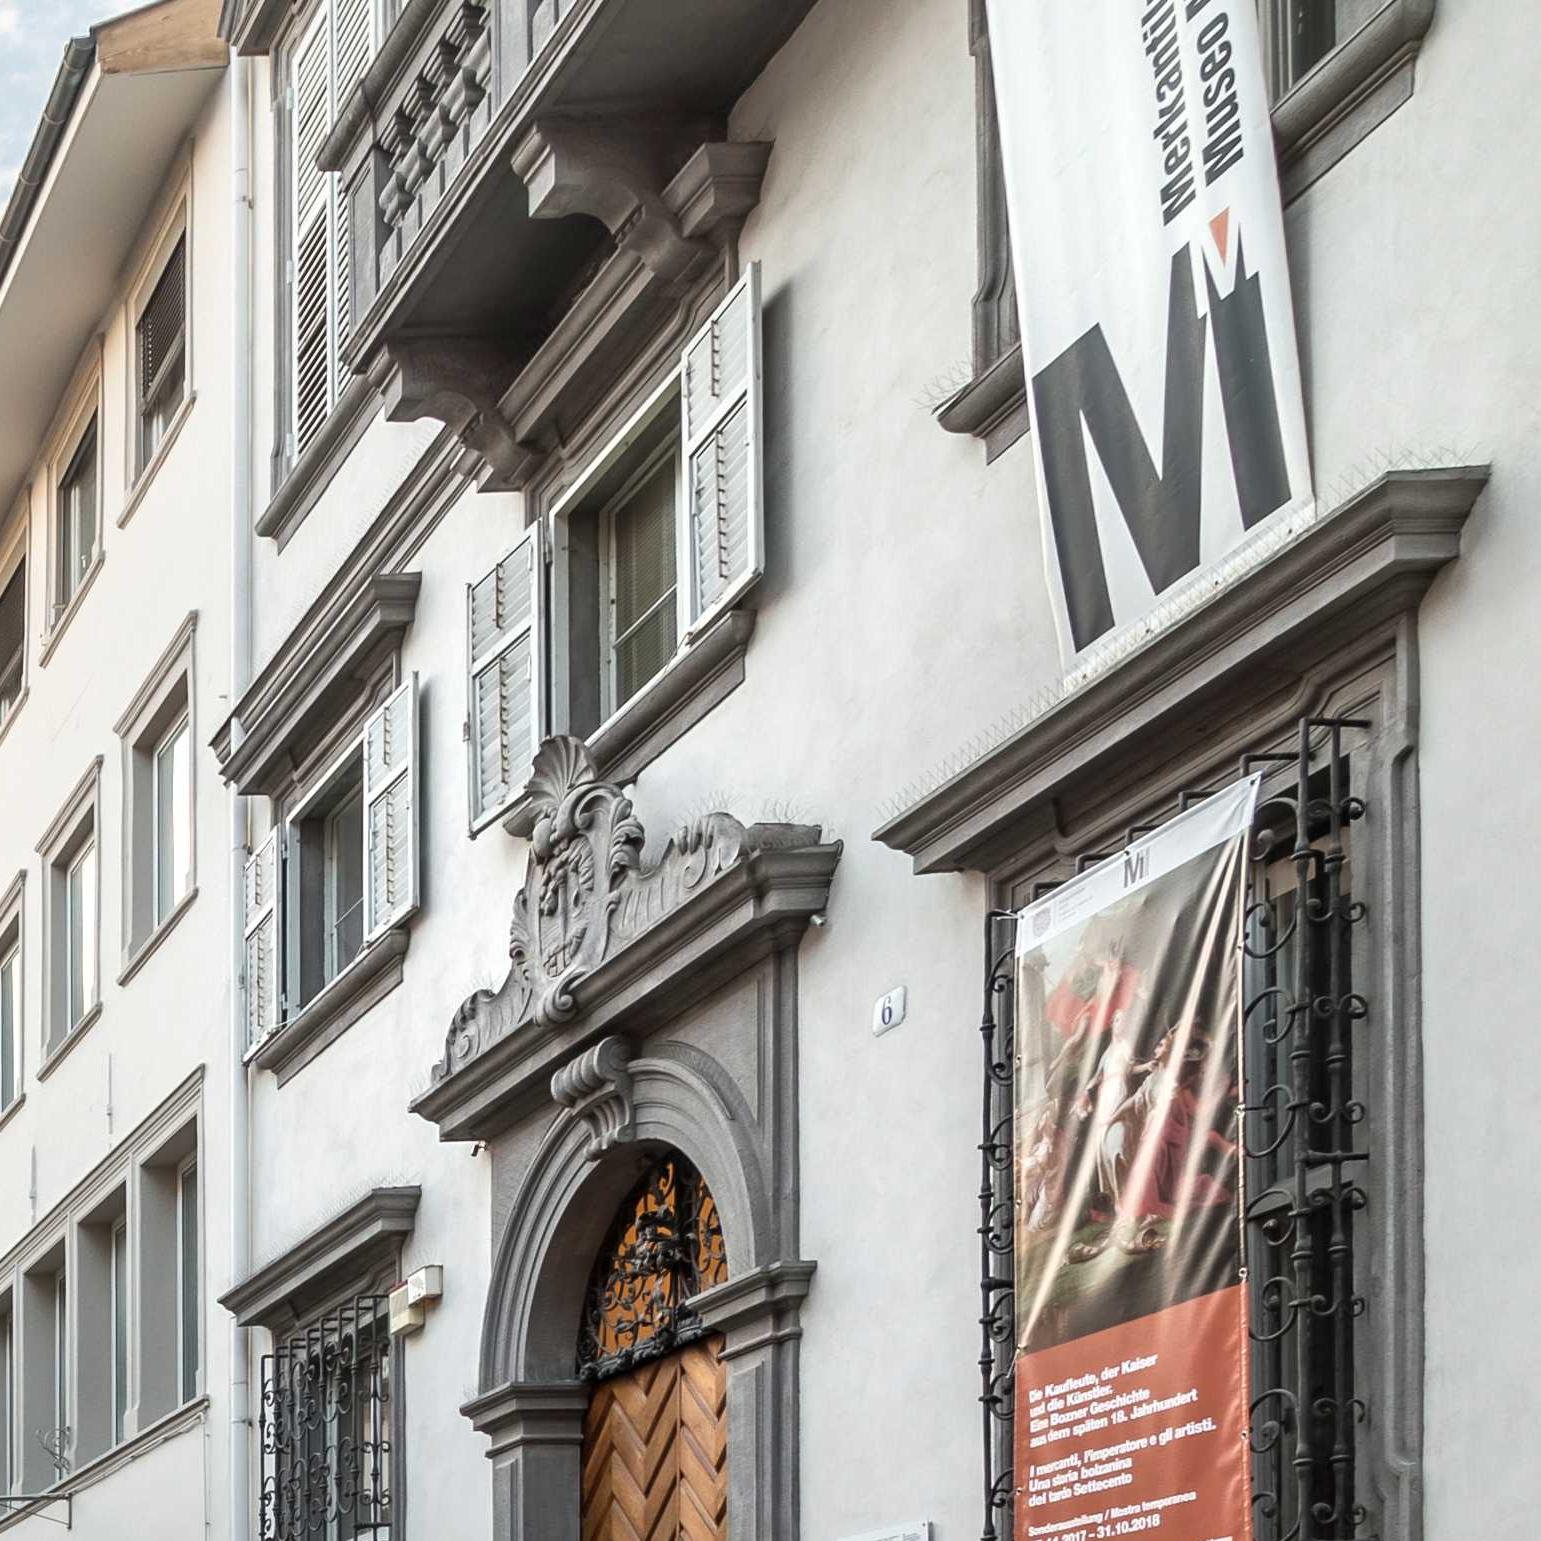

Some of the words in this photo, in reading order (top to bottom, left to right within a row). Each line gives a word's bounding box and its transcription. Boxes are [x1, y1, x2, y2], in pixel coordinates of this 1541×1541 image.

[1141, 0, 1196, 227] Merkantil
[1197, 12, 1244, 188] Museo
[882, 996, 892, 1025] 6
[1045, 1373, 1099, 1398] Kaufleute,
[1101, 1365, 1120, 1380] der
[1122, 1354, 1158, 1374] Kaiser
[1047, 1396, 1064, 1411] die
[1067, 1384, 1113, 1406] Künstler.
[1048, 1426, 1070, 1442] dem
[1073, 1413, 1108, 1437] späten
[1111, 1411, 1128, 1425] 18.
[1131, 1388, 1198, 1419] Jahrhundert
[1050, 1406, 1088, 1426] Bozner
[1090, 1388, 1150, 1415] Geschichte
[1037, 1453, 1081, 1474] mercanti,
[1150, 1434, 1157, 1445] e
[1159, 1427, 1173, 1445] gli
[1175, 1417, 1217, 1439] artisti.
[1028, 1493, 1047, 1507] del
[1073, 1472, 1133, 1495] Settecento
[1029, 1477, 1051, 1492] Una
[1081, 1457, 1132, 1478] bolzanina
[1110, 1504, 1141, 1518] Mostra
[1142, 1491, 1197, 1511] temporanea
[1097, 1513, 1160, 1539] 31.10.2018
